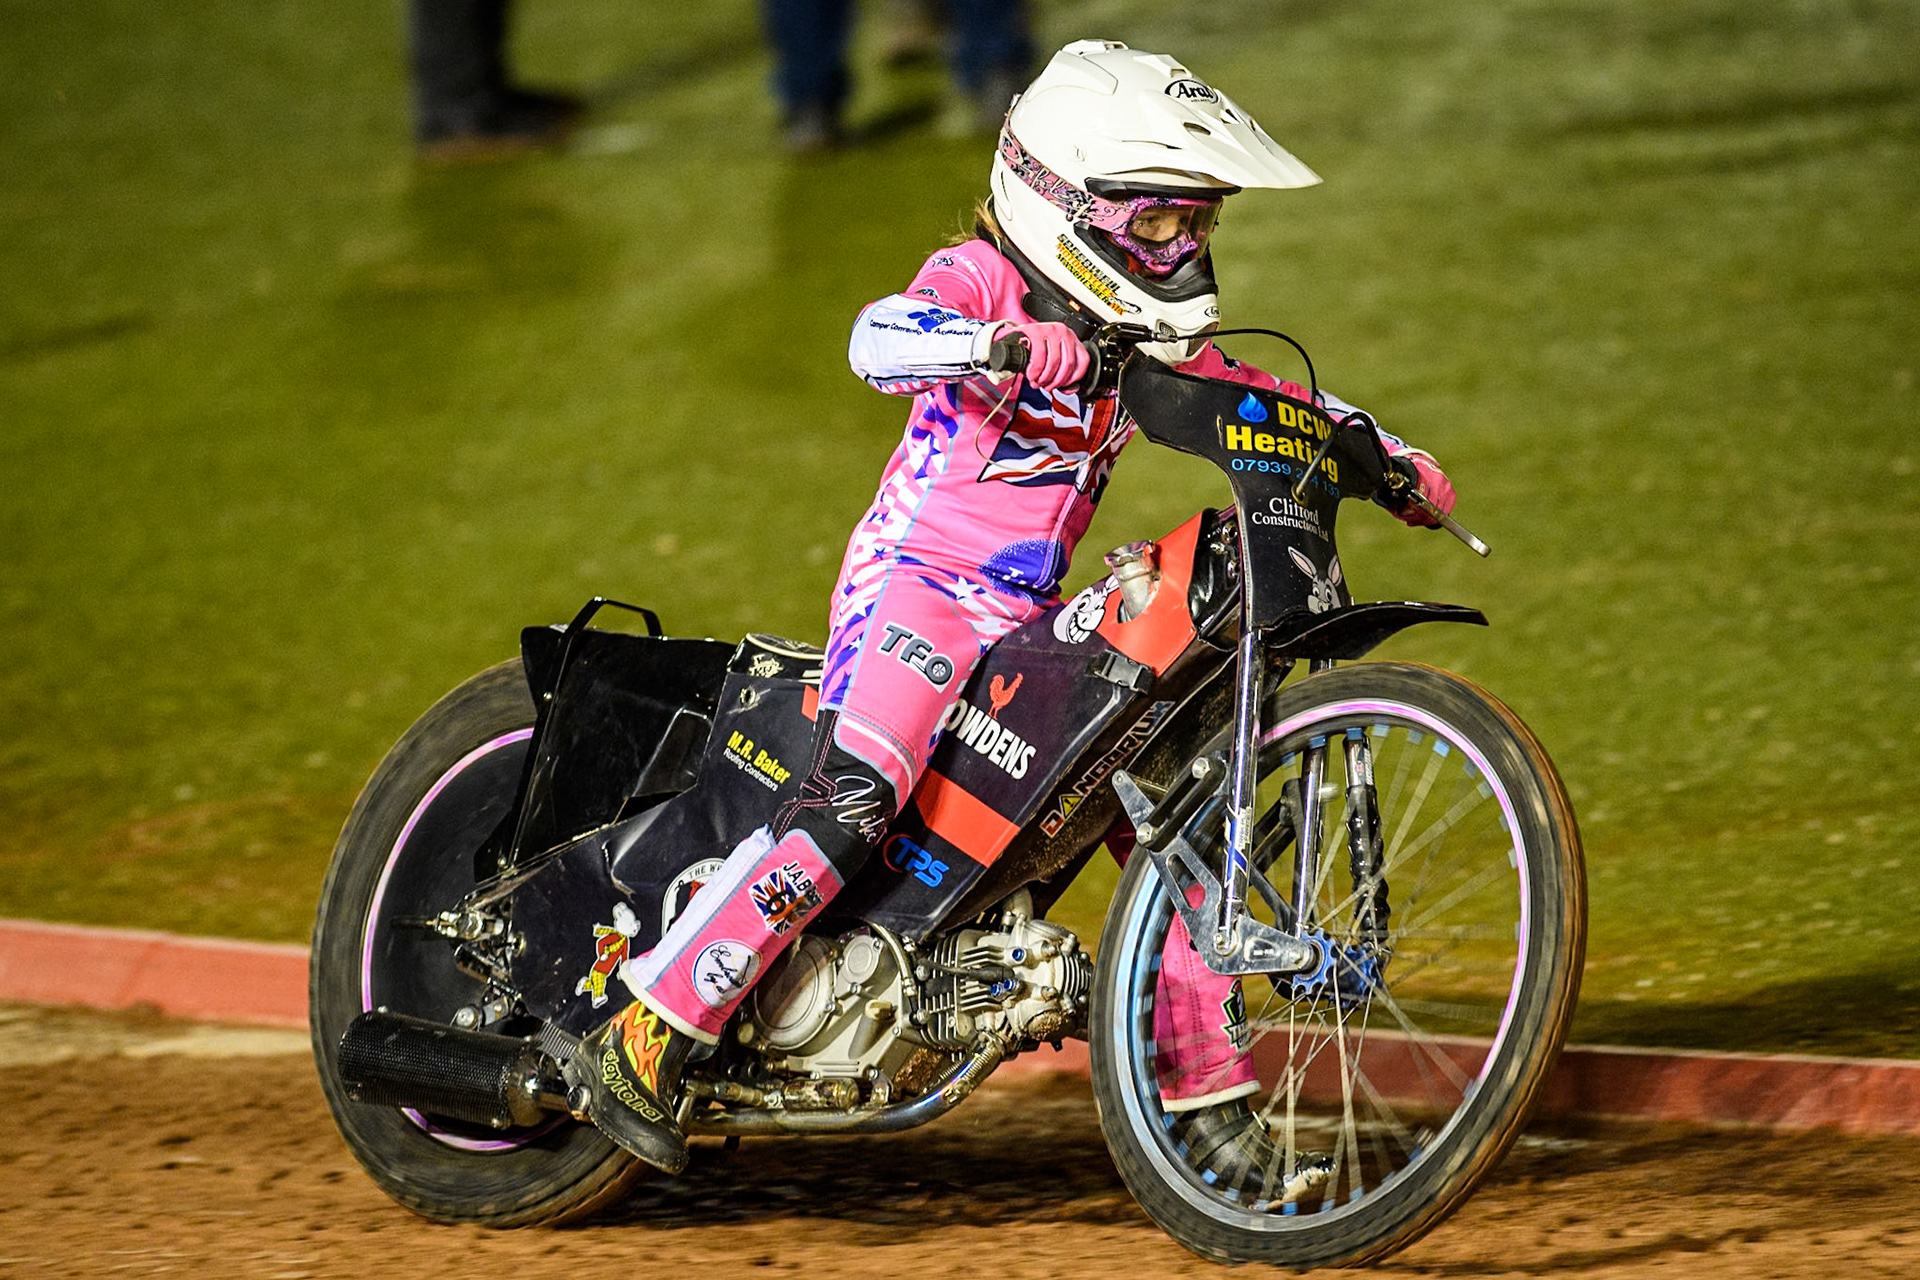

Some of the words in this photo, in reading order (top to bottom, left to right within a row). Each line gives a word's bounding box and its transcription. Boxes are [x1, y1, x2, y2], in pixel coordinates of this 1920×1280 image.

[1277, 401, 1332, 441] DCW
[1231, 458, 1292, 475] 07939
[1251, 511, 1318, 535] Construction
[727, 730, 754, 761] M.R.
[753, 749, 791, 784] Baker
[944, 698, 1037, 780] OWDENS
[723, 747, 745, 770] Roofing
[744, 762, 779, 792] Contractors
[688, 864, 707, 879] THE
[894, 837, 950, 888] TPS
[602, 1048, 664, 1122] daytona
